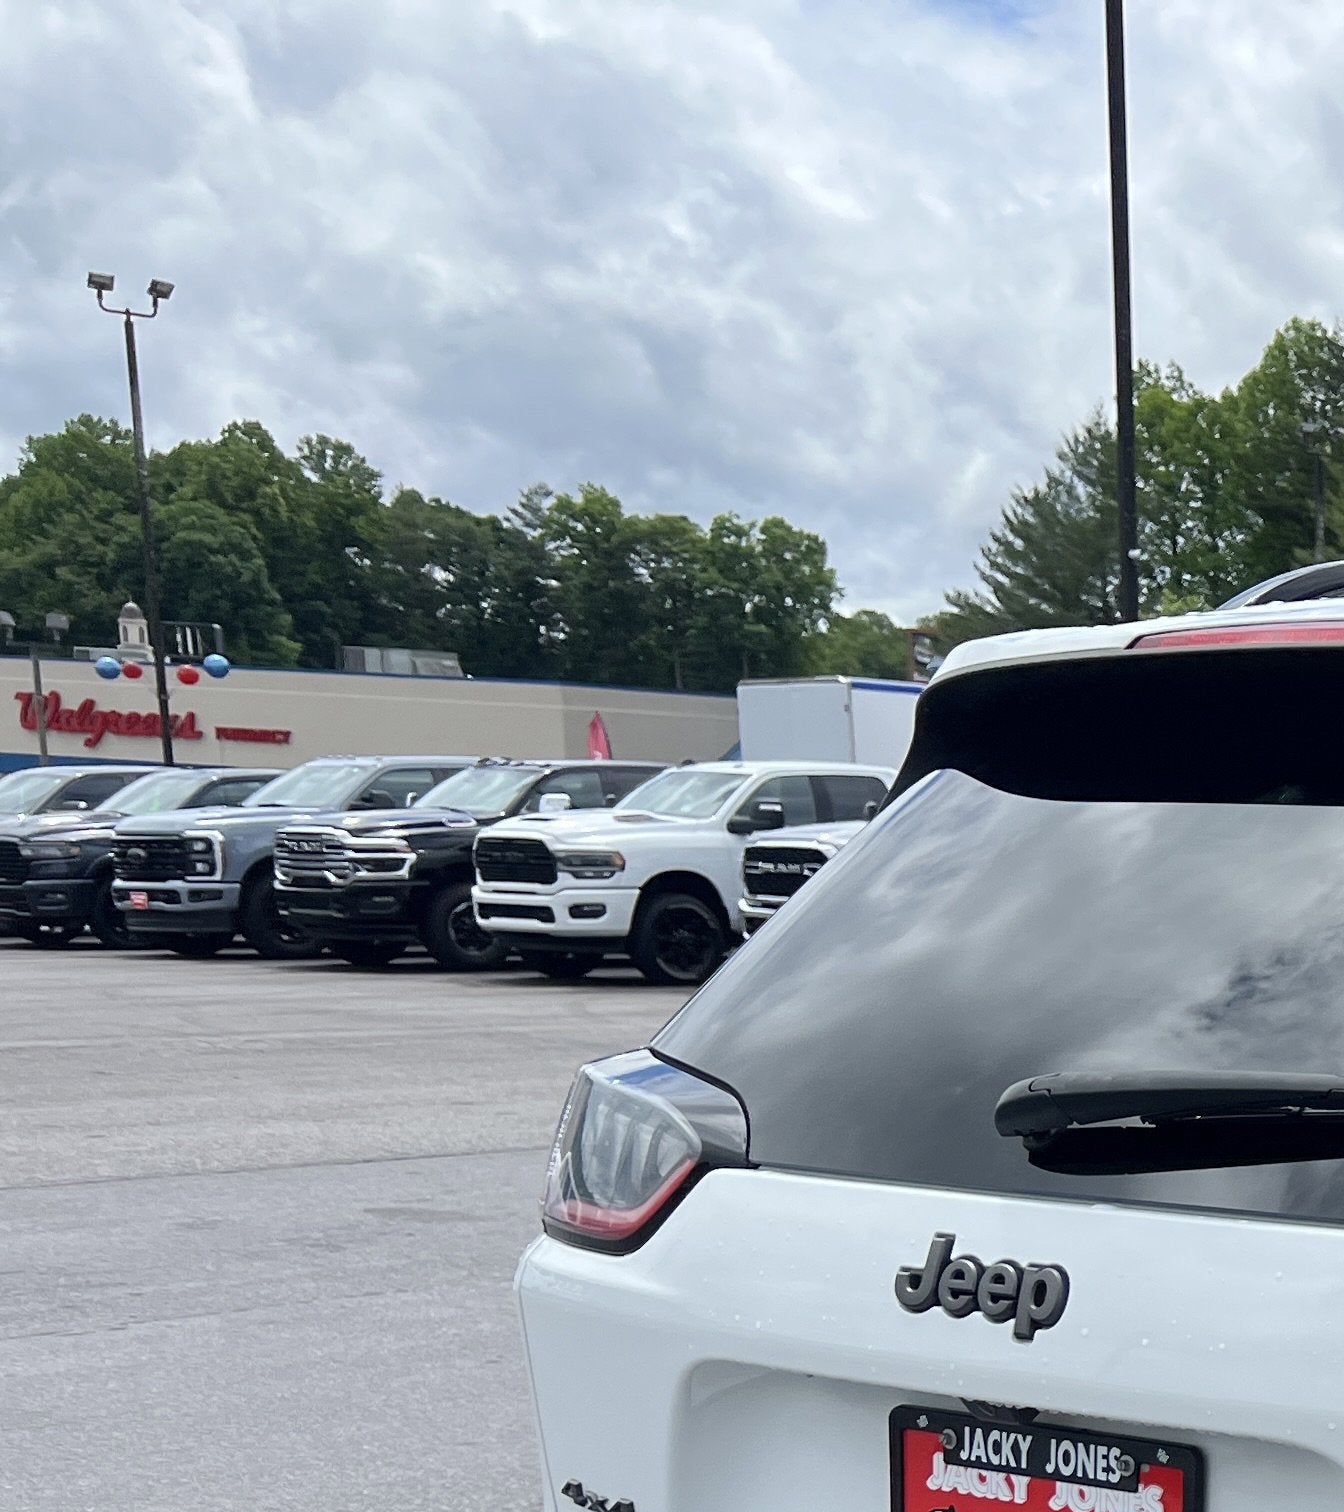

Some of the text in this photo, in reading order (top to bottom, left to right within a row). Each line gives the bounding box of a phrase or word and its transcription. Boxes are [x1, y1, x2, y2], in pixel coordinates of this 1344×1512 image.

[894, 1231, 1070, 1342] Jeep
[959, 1425, 1123, 1483] JACKY JONES
